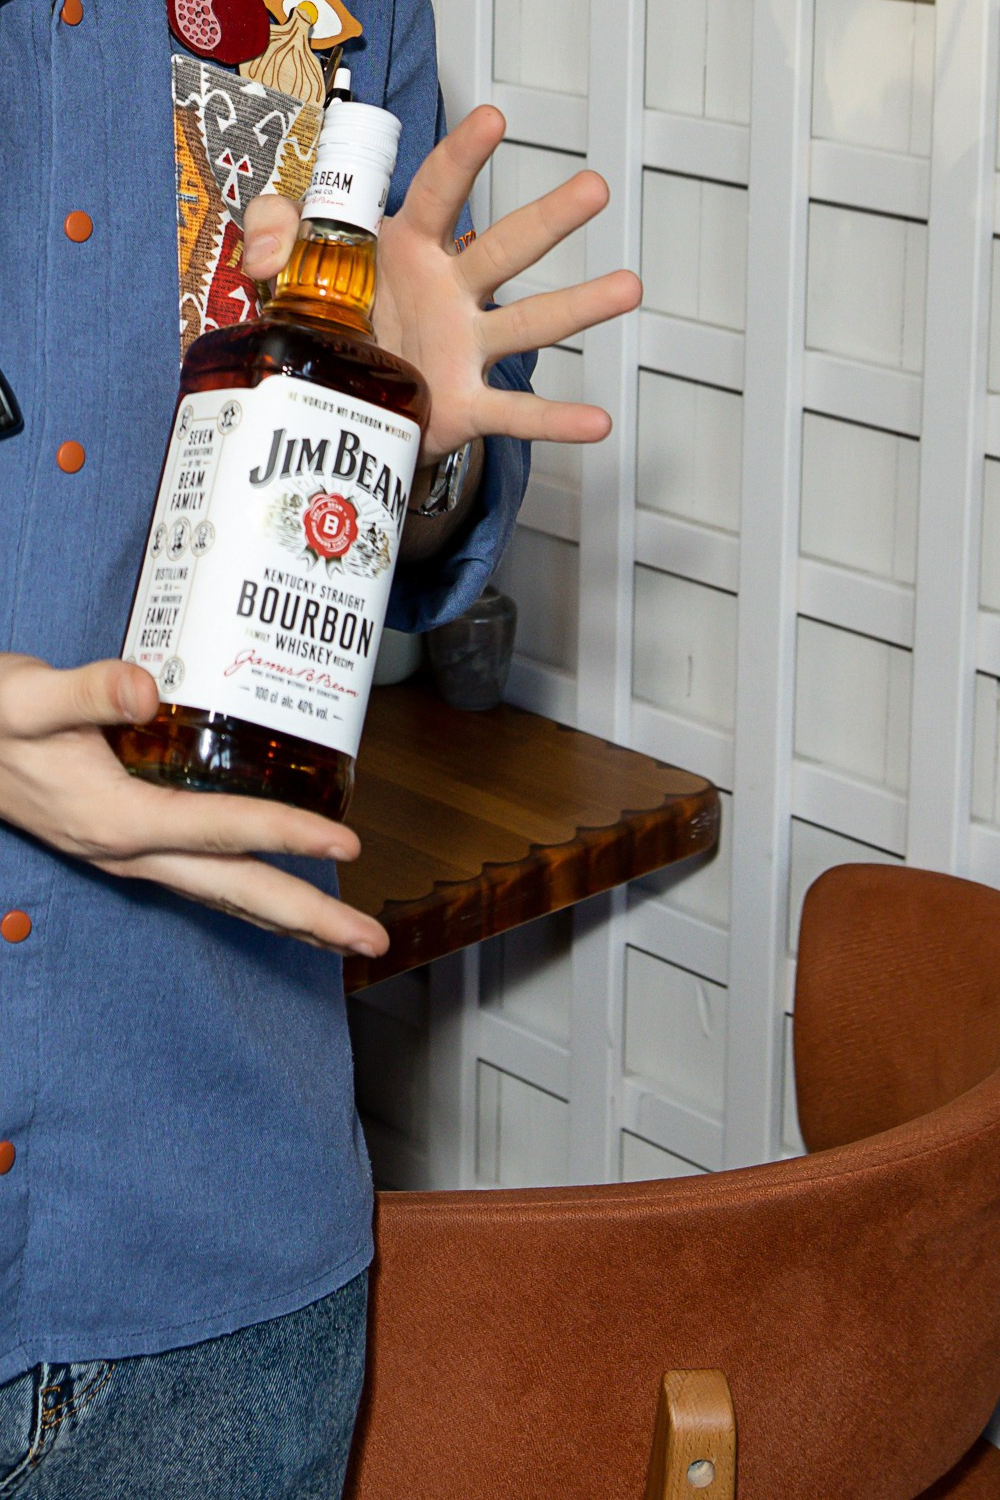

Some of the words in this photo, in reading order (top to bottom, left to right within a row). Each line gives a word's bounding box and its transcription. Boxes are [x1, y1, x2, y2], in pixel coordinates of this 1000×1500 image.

[319, 171, 354, 194] BEAM
[188, 428, 214, 446] SEVEN
[178, 470, 206, 490] BEAM
[249, 428, 331, 489] JIM
[332, 429, 408, 532] BEAM
[170, 492, 206, 512] FAMILY
[323, 513, 340, 536] B
[264, 567, 317, 594] KENTUCKY
[319, 585, 366, 613] STRAIGHT
[144, 607, 179, 627] FAMILY
[236, 579, 375, 659] BOURBON
[140, 629, 174, 648] RECIPE
[275, 632, 334, 667] WHISKEY
